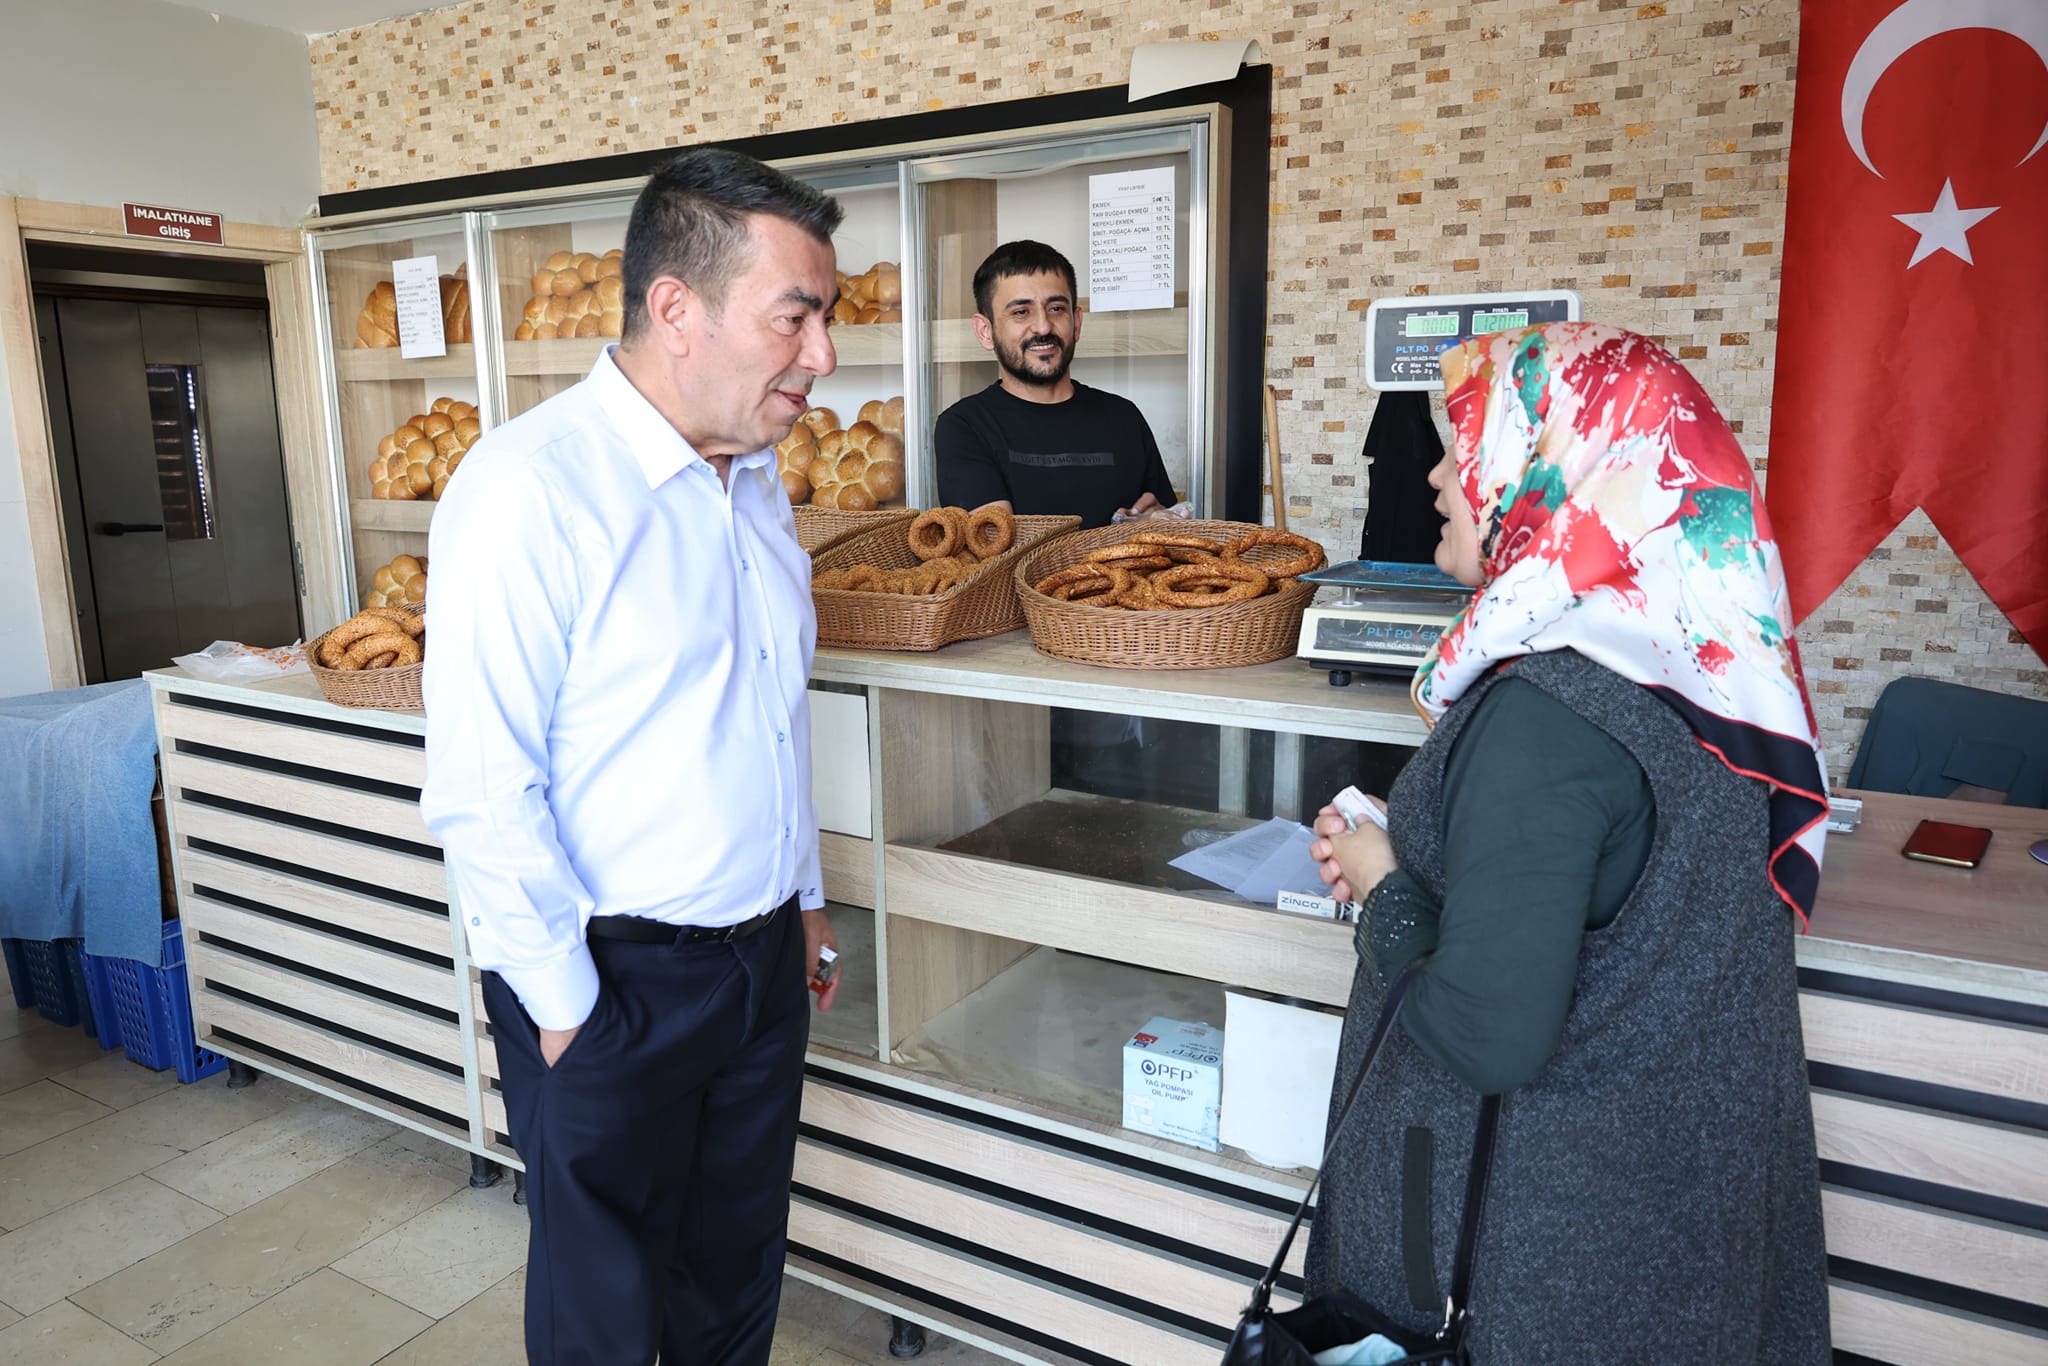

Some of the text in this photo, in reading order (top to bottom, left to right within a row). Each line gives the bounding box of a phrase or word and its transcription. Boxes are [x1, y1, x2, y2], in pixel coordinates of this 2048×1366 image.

[132, 205, 213, 227] İMALATHANE
[159, 224, 191, 240] GİRİŞ
[1134, 226, 1150, 234] AÇMA
[1395, 345, 1415, 354] PLT
[1367, 626, 1392, 638] PLT
[1144, 1077, 1194, 1096] YAĞ POMPASI
[1151, 1088, 1186, 1102] OIL PUMP
